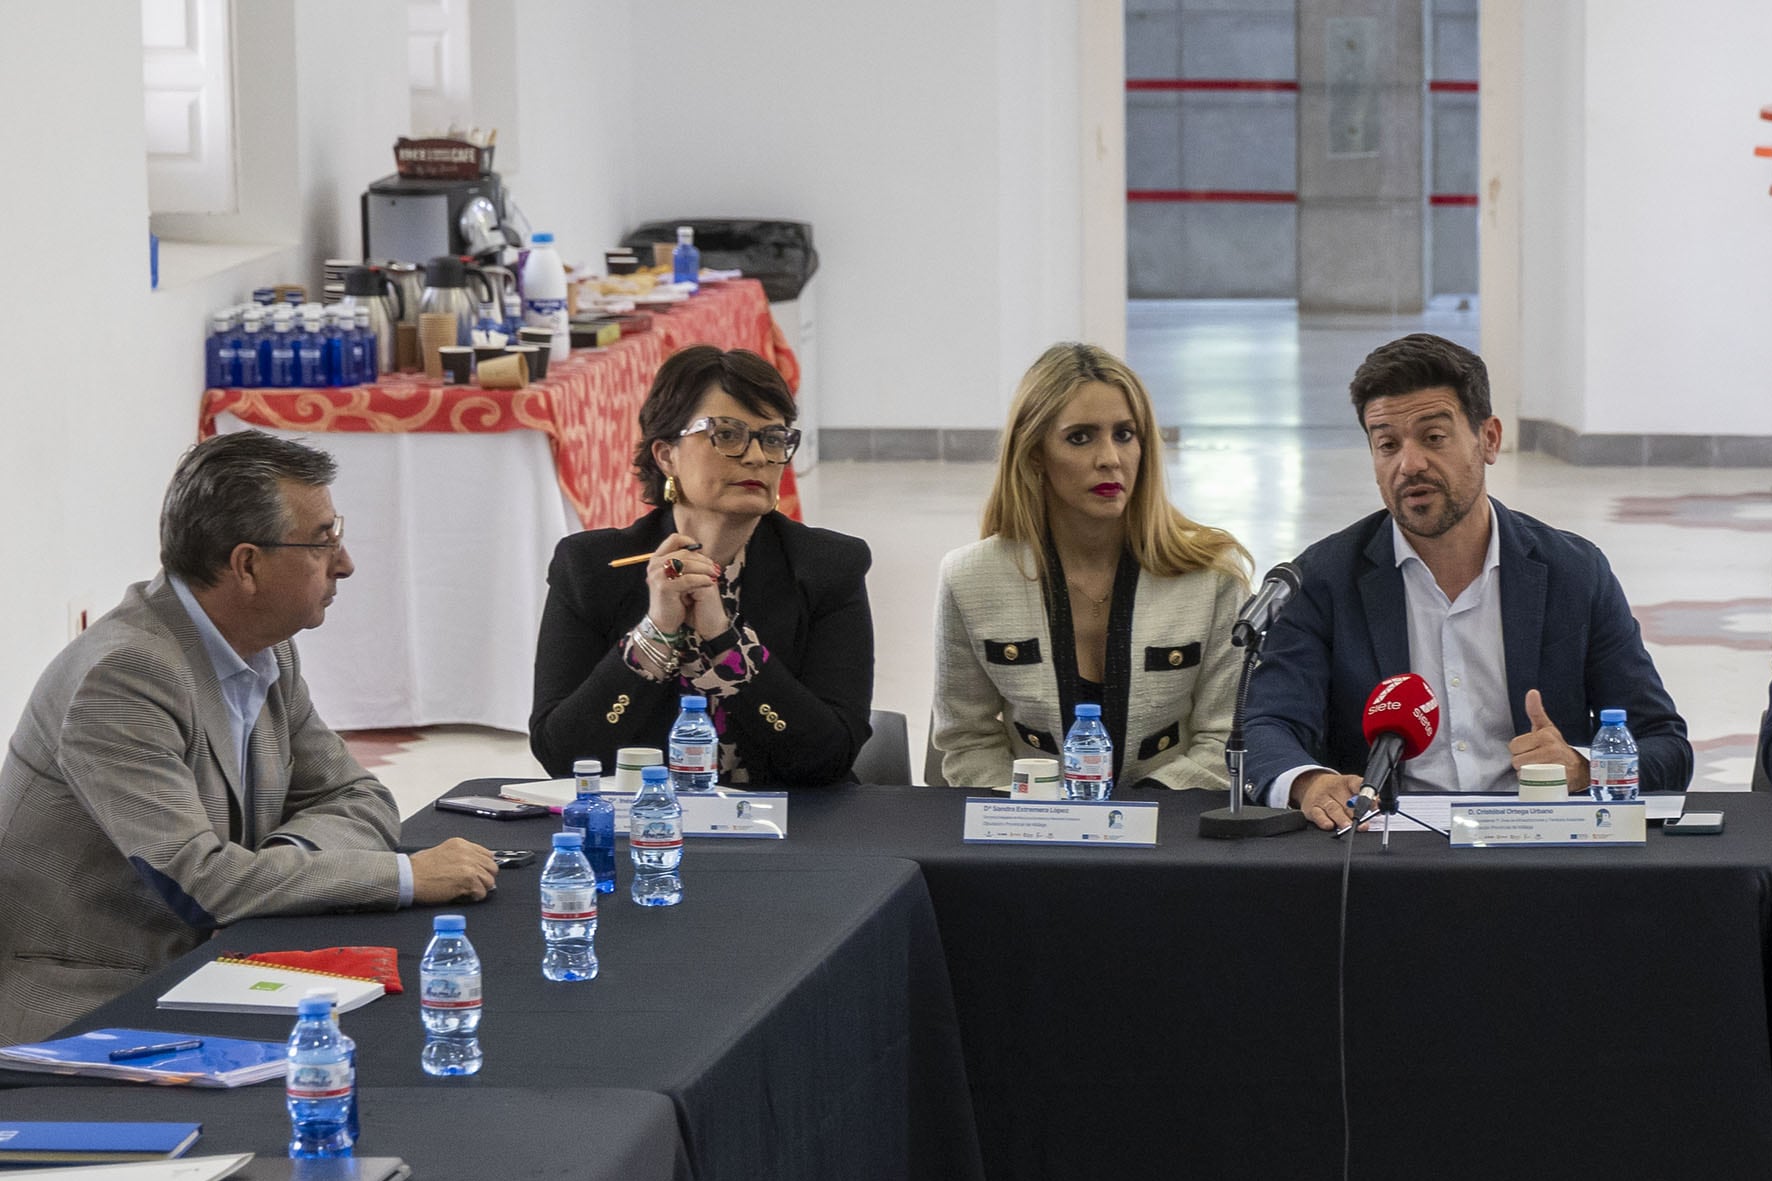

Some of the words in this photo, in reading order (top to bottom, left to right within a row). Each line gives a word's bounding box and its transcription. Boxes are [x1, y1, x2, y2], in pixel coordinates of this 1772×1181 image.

[1368, 701, 1401, 715] siete
[1412, 707, 1433, 736] siete
[1506, 808, 1529, 816] Ortega
